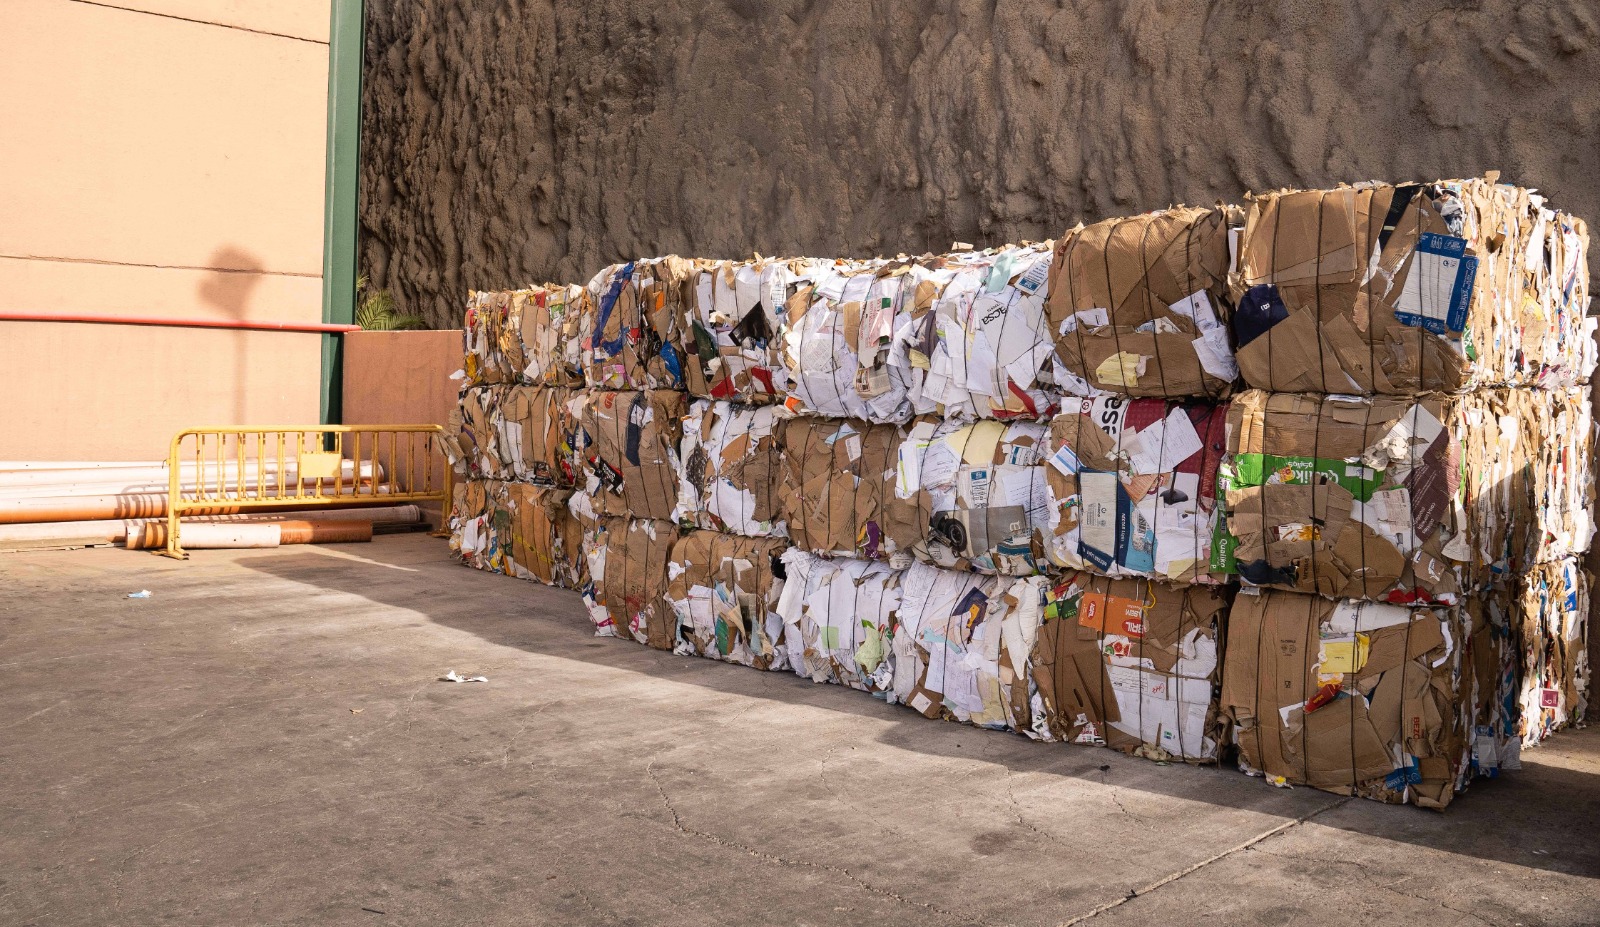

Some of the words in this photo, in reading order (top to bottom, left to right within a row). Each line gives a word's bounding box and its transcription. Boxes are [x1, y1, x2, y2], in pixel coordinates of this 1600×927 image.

[1290, 469, 1339, 484] Qlik
[1219, 538, 1228, 568] Qualiko
[1125, 621, 1146, 634] BRIL
